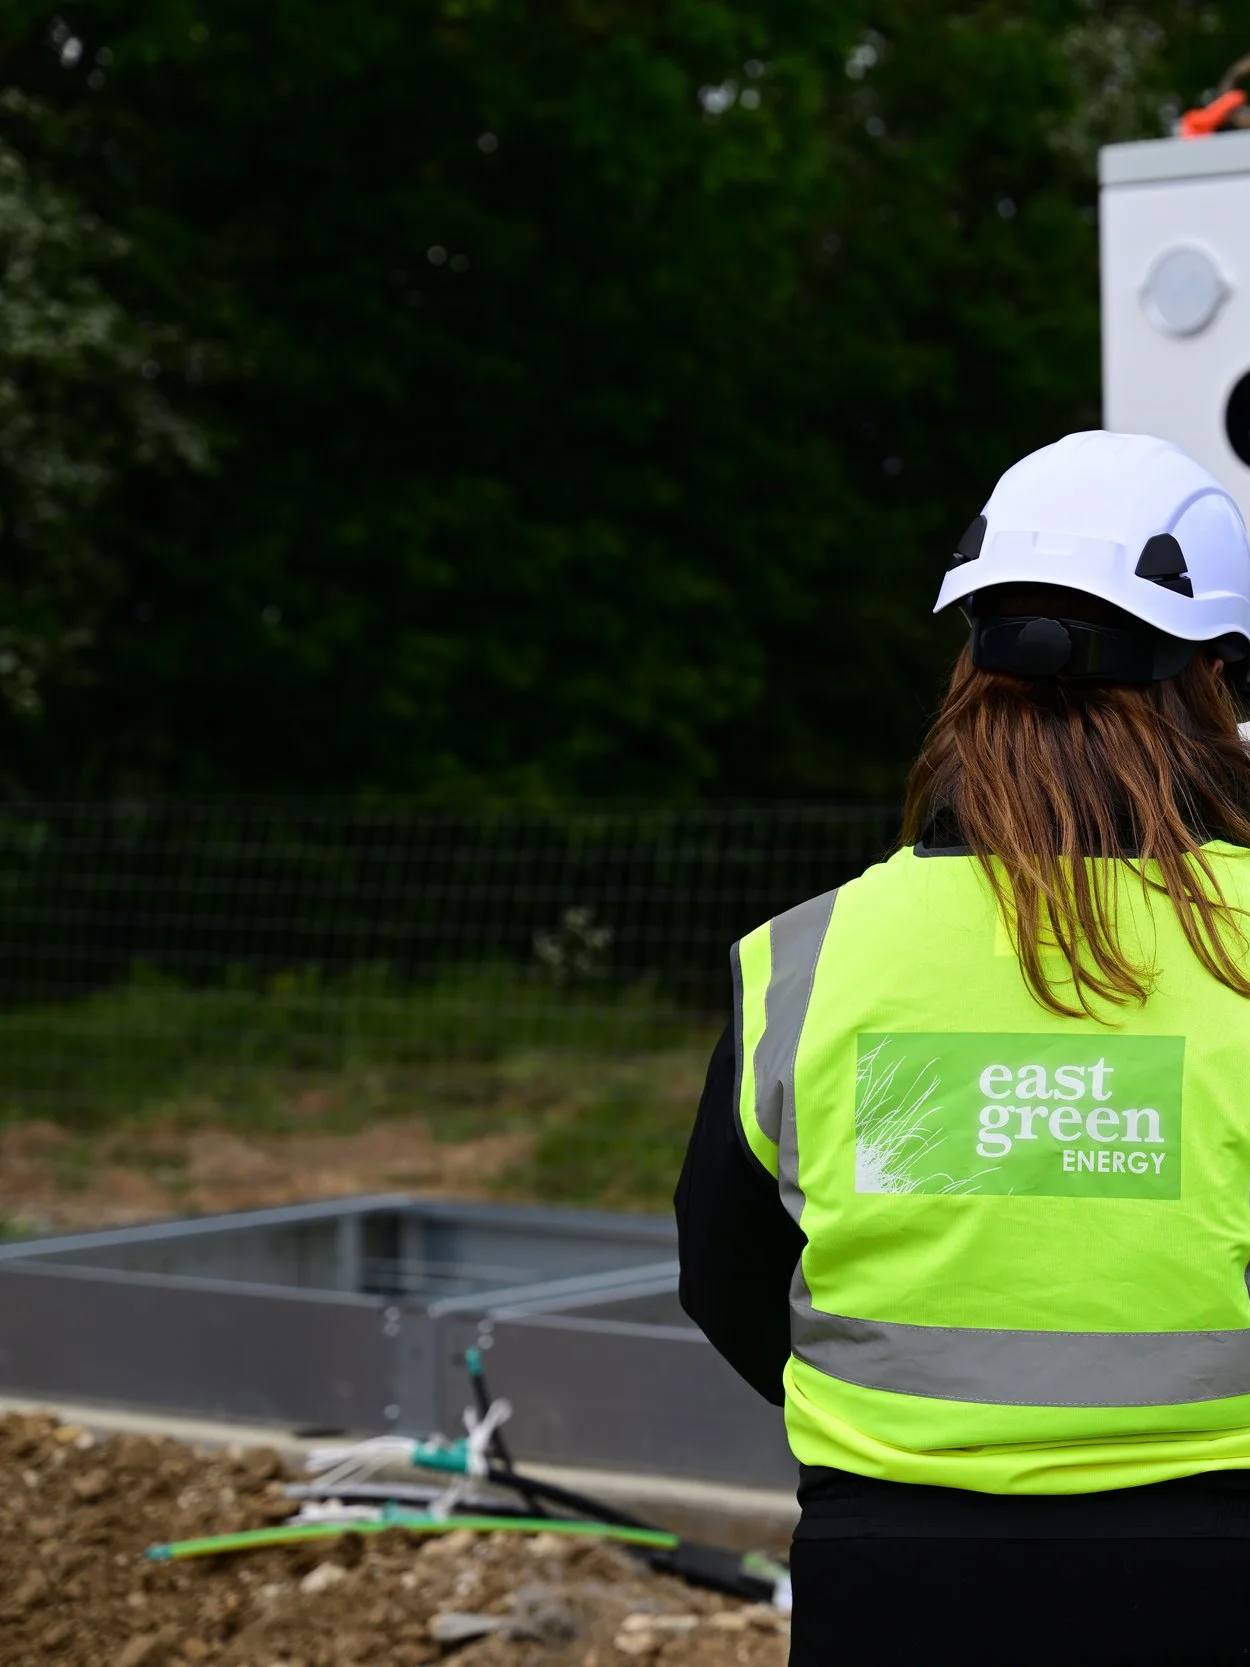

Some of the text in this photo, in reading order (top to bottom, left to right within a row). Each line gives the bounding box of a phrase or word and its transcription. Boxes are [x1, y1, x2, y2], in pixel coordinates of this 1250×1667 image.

[979, 1057, 1114, 1101] east
[976, 1104, 1164, 1158] green
[1063, 1150, 1165, 1174] ENERGY
